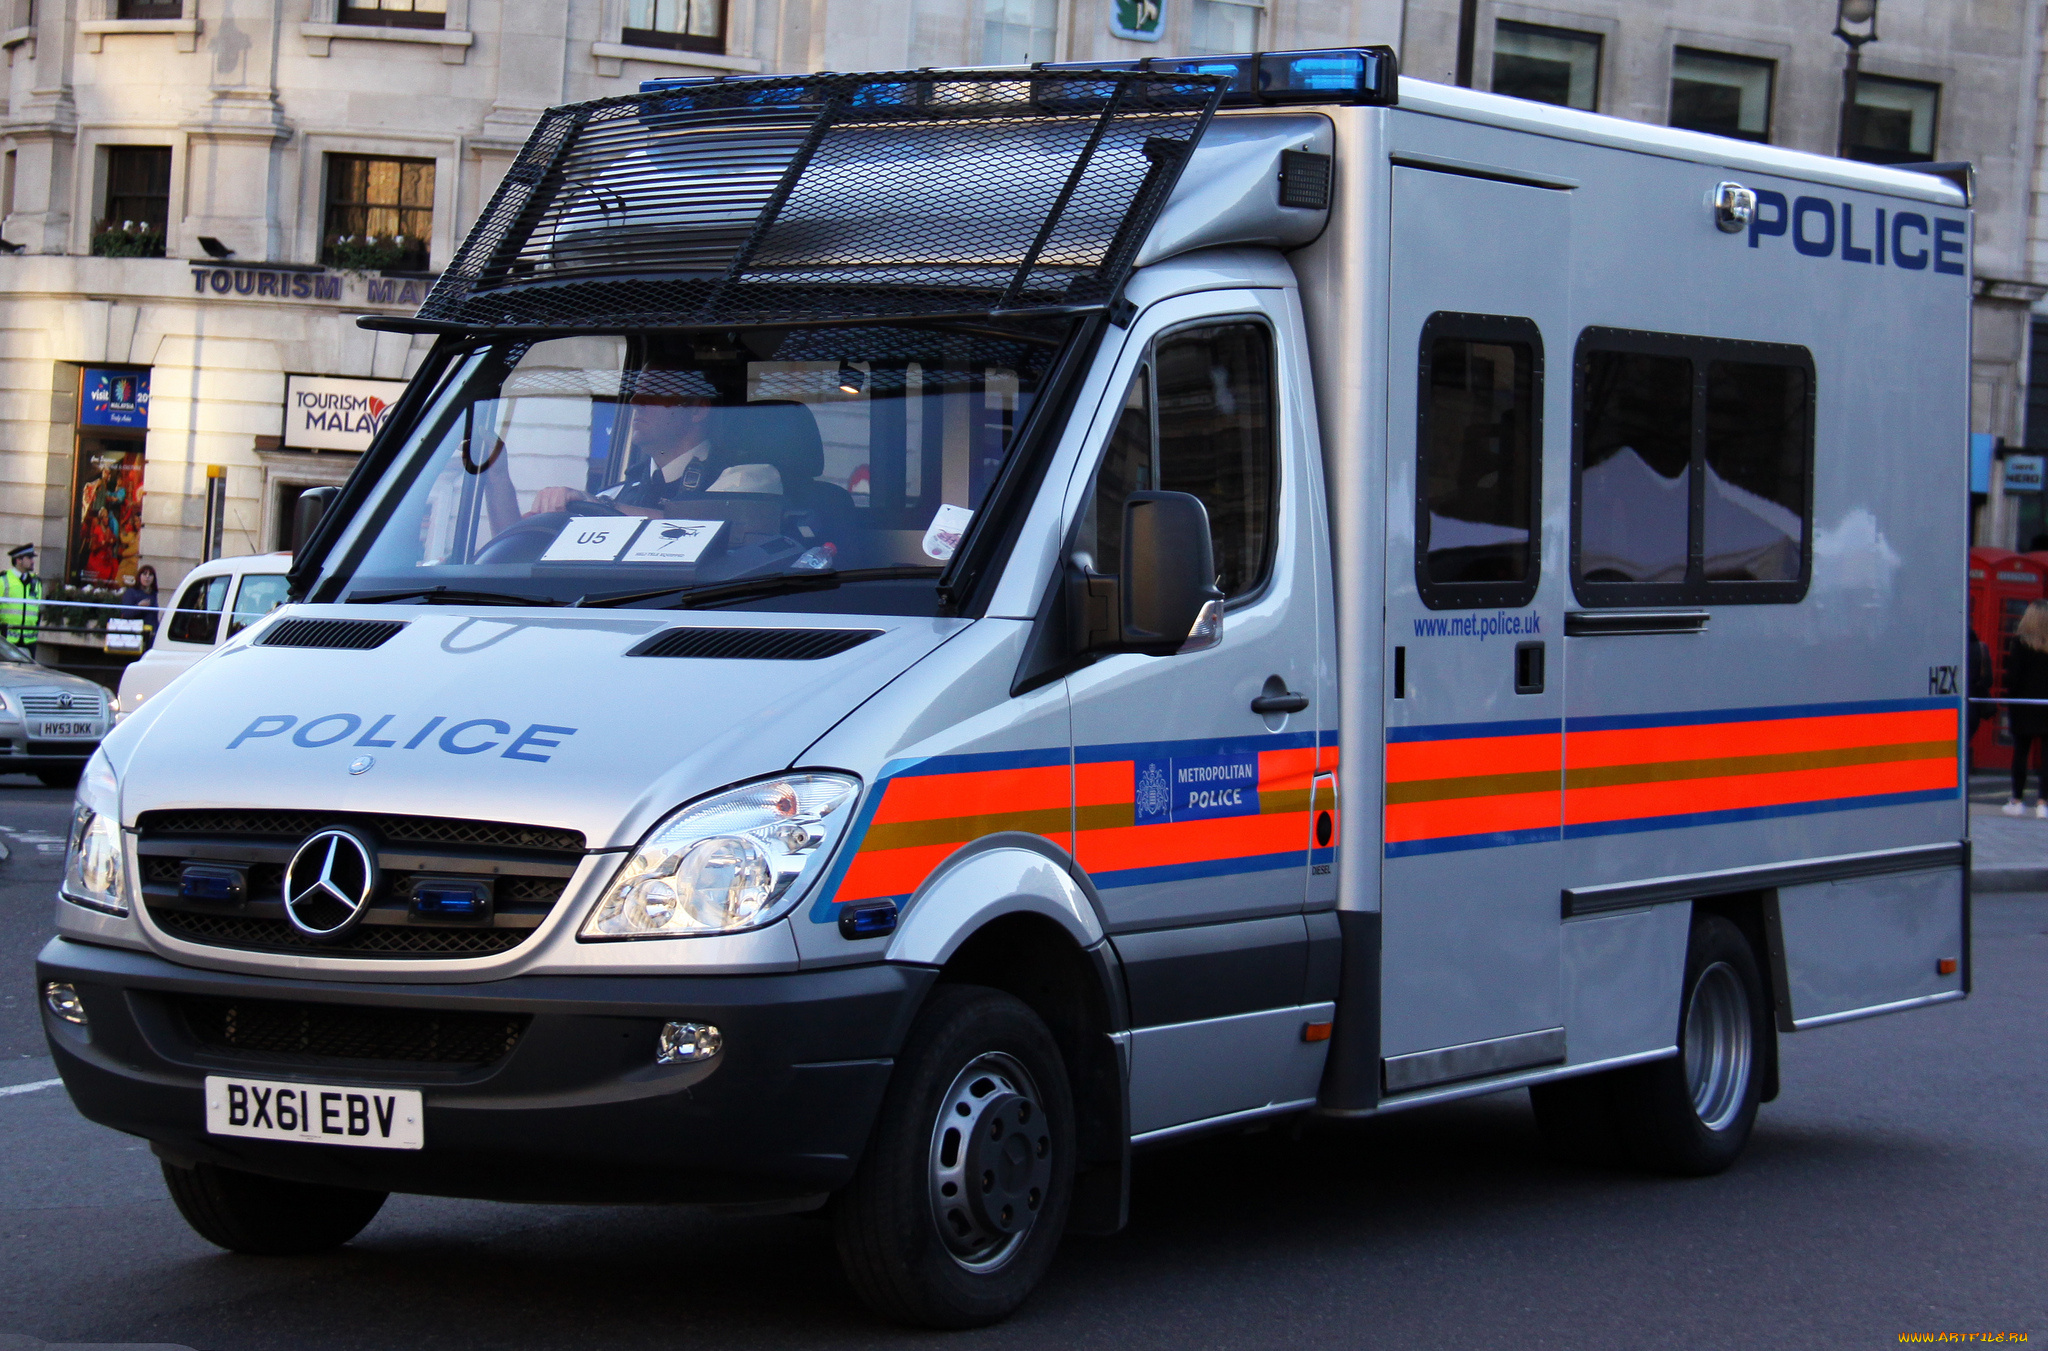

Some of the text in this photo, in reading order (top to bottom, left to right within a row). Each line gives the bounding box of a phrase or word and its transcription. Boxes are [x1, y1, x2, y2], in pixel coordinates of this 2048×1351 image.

[1748, 187, 1965, 276] POLICE
[191, 268, 343, 300] TOURISM
[296, 391, 368, 411] TOURISM
[577, 531, 609, 545] U5
[1413, 610, 1541, 642] www.met.police.uk
[1928, 665, 1958, 695] HZX
[45, 722, 72, 734] HV53
[225, 713, 579, 763] POLICE
[1178, 763, 1253, 783] METROPOLITAN
[1188, 788, 1243, 809] POLICE
[227, 1084, 396, 1138] BX61 EBV
